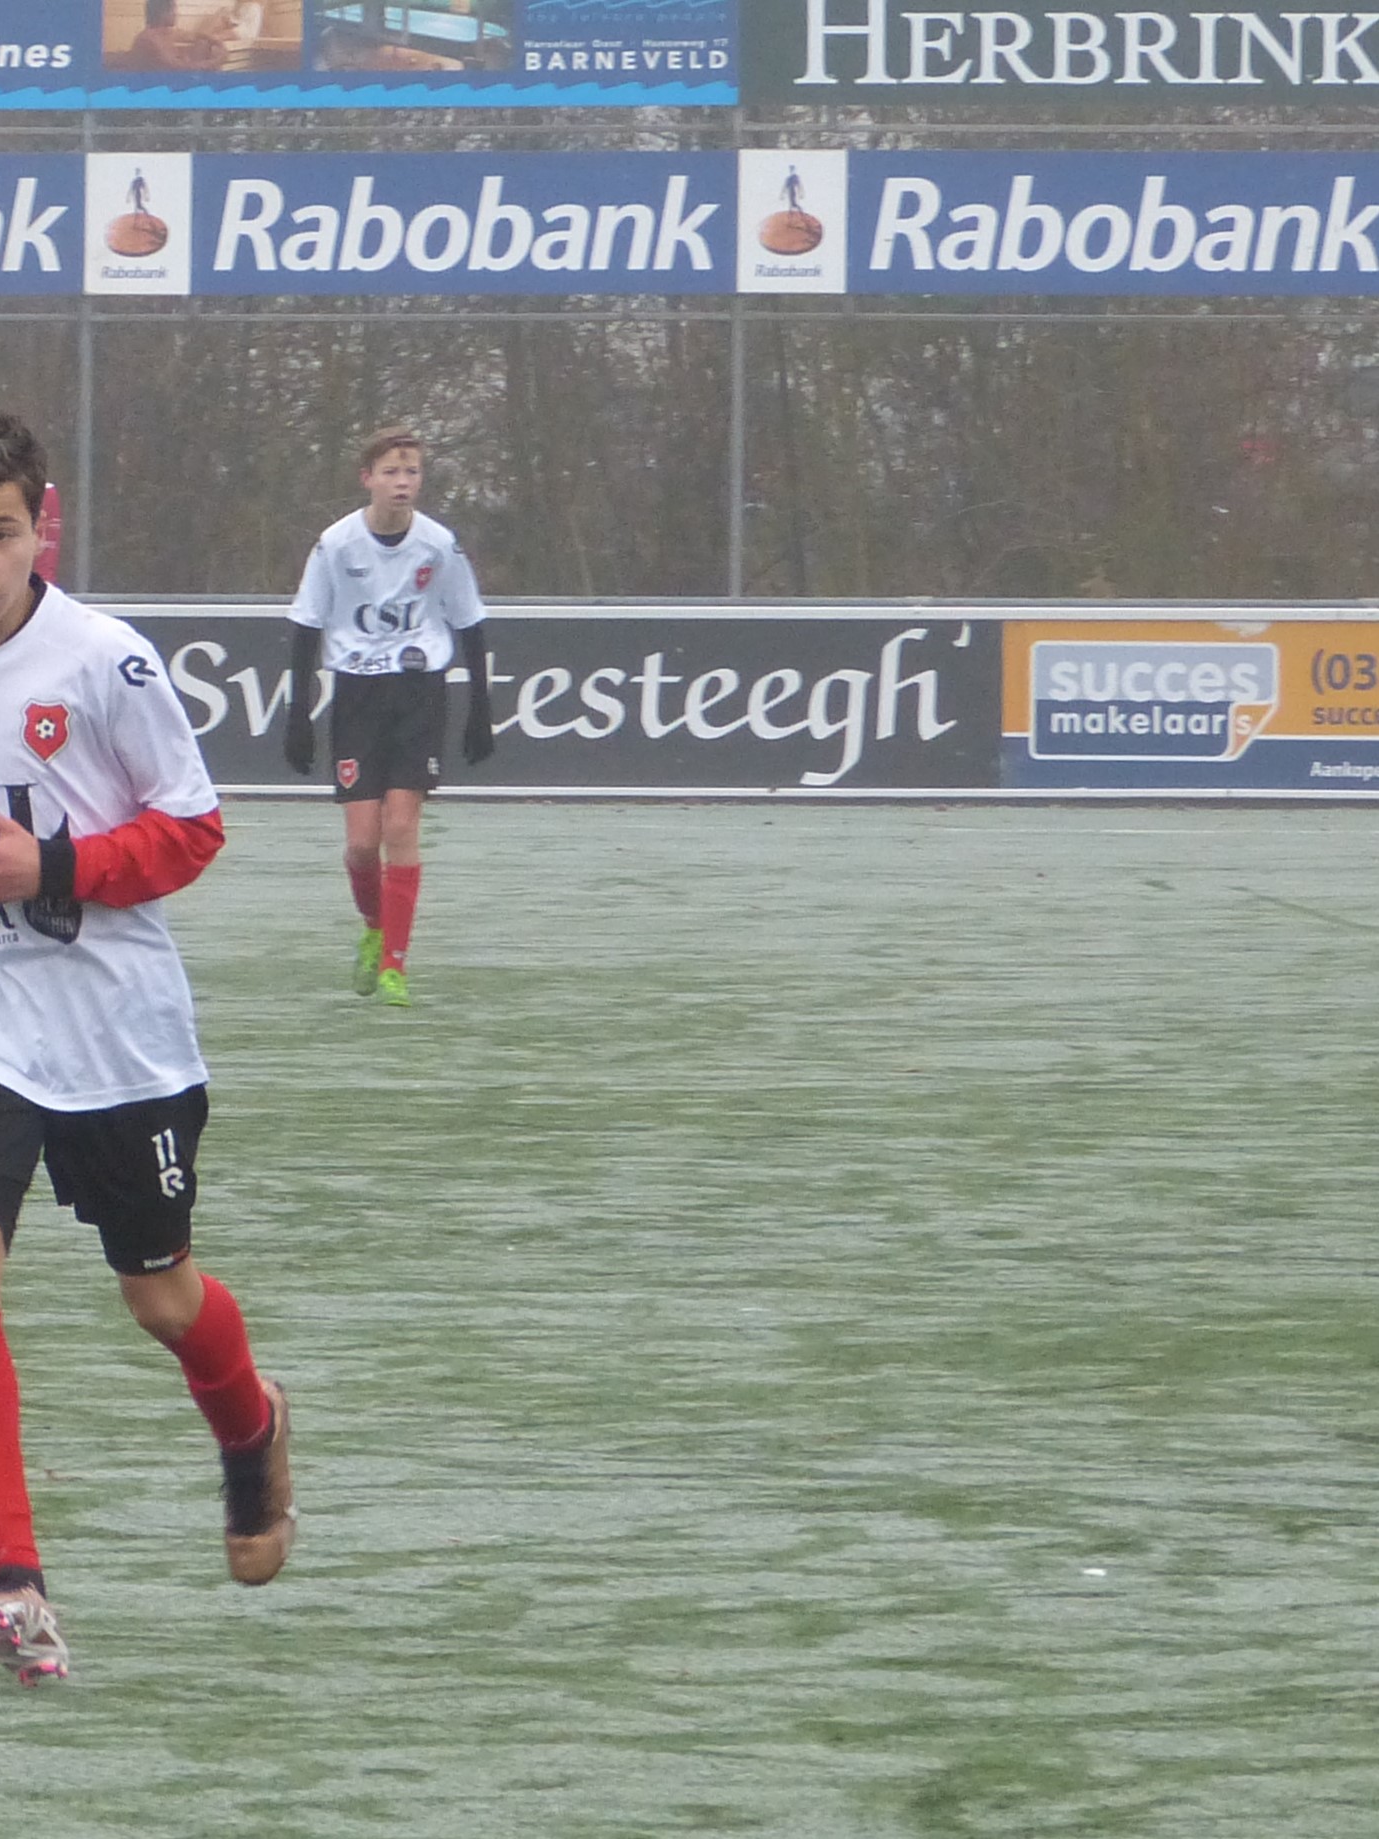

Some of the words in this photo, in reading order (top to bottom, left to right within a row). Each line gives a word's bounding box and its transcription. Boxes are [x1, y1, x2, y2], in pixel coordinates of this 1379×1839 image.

[525, 51, 728, 71] BARNEVELD
[214, 176, 719, 272] Rabobank
[870, 176, 1379, 272] Rabobank
[1048, 661, 1260, 703] succes
[1050, 705, 1253, 735] makelaars
[1313, 706, 1379, 726] succ
[152, 1128, 177, 1170] 11
